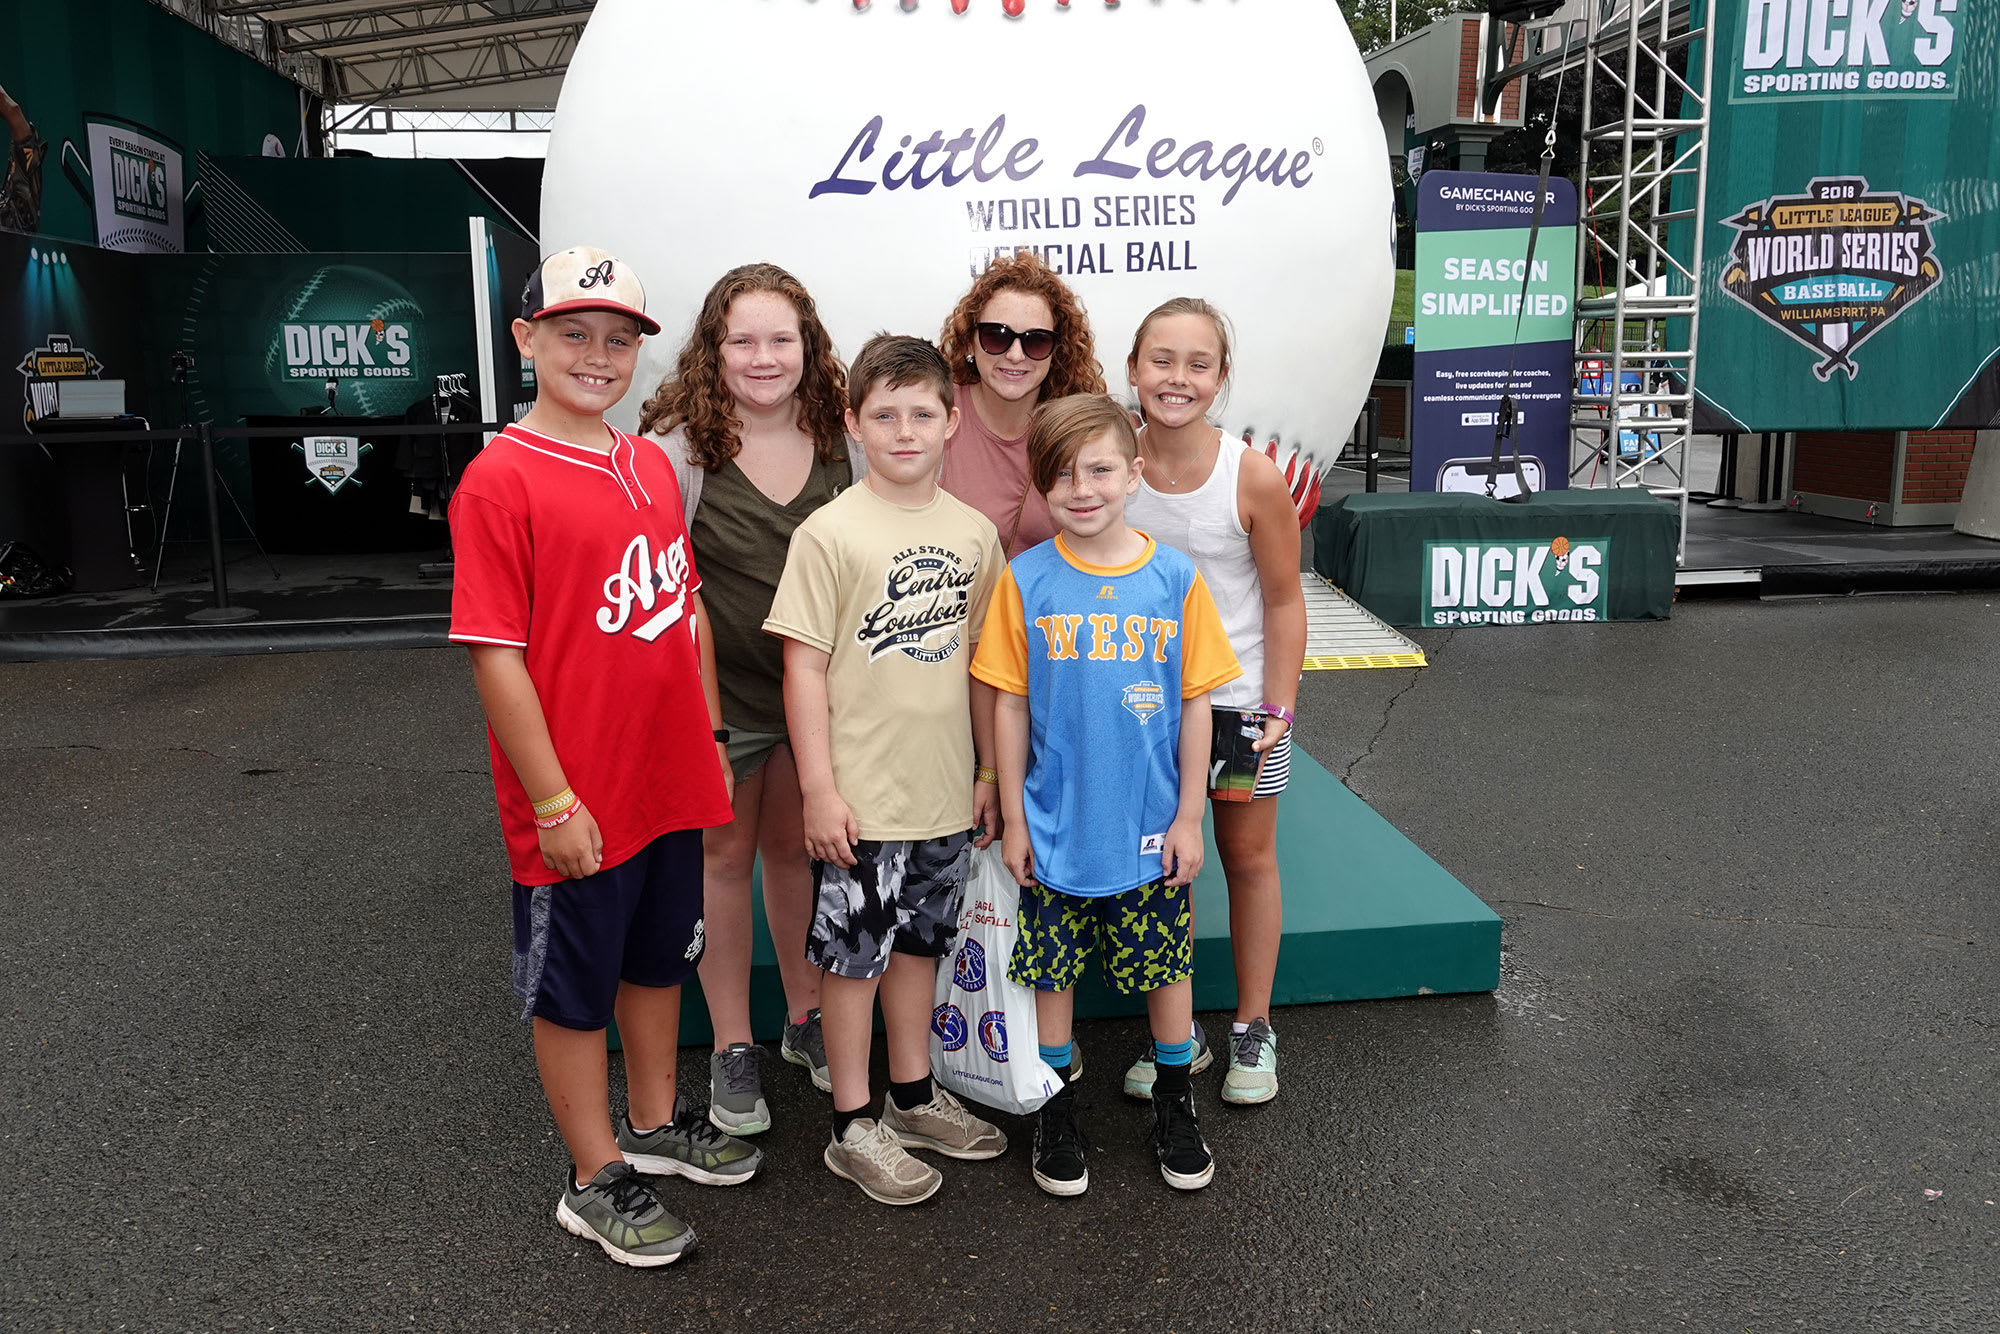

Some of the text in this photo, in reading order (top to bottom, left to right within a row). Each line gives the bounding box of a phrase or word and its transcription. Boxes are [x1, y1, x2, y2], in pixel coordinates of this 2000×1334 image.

[1743, 0, 1958, 70] DICK'S
[1744, 70, 1947, 93] SPORTING GOODS
[109, 136, 125, 148] EVERY
[125, 141, 143, 155] SEASON
[144, 147, 160, 160] STARTS
[808, 104, 1314, 206] Little League
[113, 152, 166, 208] DICK'S
[1439, 187, 1555, 204] GAMECHANGR
[1821, 186, 1855, 199] 2018
[118, 200, 146, 216] SPORTING
[966, 195, 1195, 233] WORLD SERIES
[1465, 204, 1486, 212] DICK'S
[1487, 205, 1518, 213] SPORTING
[1519, 206, 1534, 214] GOO
[1779, 207, 1892, 225] LITTLE LEAGUE
[1126, 240, 1198, 273] BALL
[1748, 232, 1920, 282] WORLD SERIES
[1444, 257, 1548, 282] SEASON
[1783, 282, 1883, 300] BASEBALL
[1421, 292, 1568, 316] SIMPLIFIED
[1870, 306, 1886, 317] PA
[53, 342, 69, 353] 2018
[284, 324, 411, 366] DICK'S
[40, 361, 84, 373] LITTLE LEAGUE
[290, 367, 410, 377] SPORTING GOODS
[1435, 370, 1455, 380] Easy,
[1455, 370, 1469, 378] free
[1470, 370, 1510, 379] scorekeepin
[1468, 382, 1494, 390] updates
[1424, 394, 1454, 402] seamless
[1531, 393, 1562, 401] everyone
[315, 442, 346, 454] DICK'S
[892, 545, 962, 565] ALL STARS
[1431, 544, 1602, 608] DICK'S
[1433, 608, 1597, 625] SPORTING GOODS
[896, 633, 920, 643] 2018
[1035, 613, 1178, 663] WEST
[952, 1069, 1004, 1087] LITTLELEAGUE.ORG
